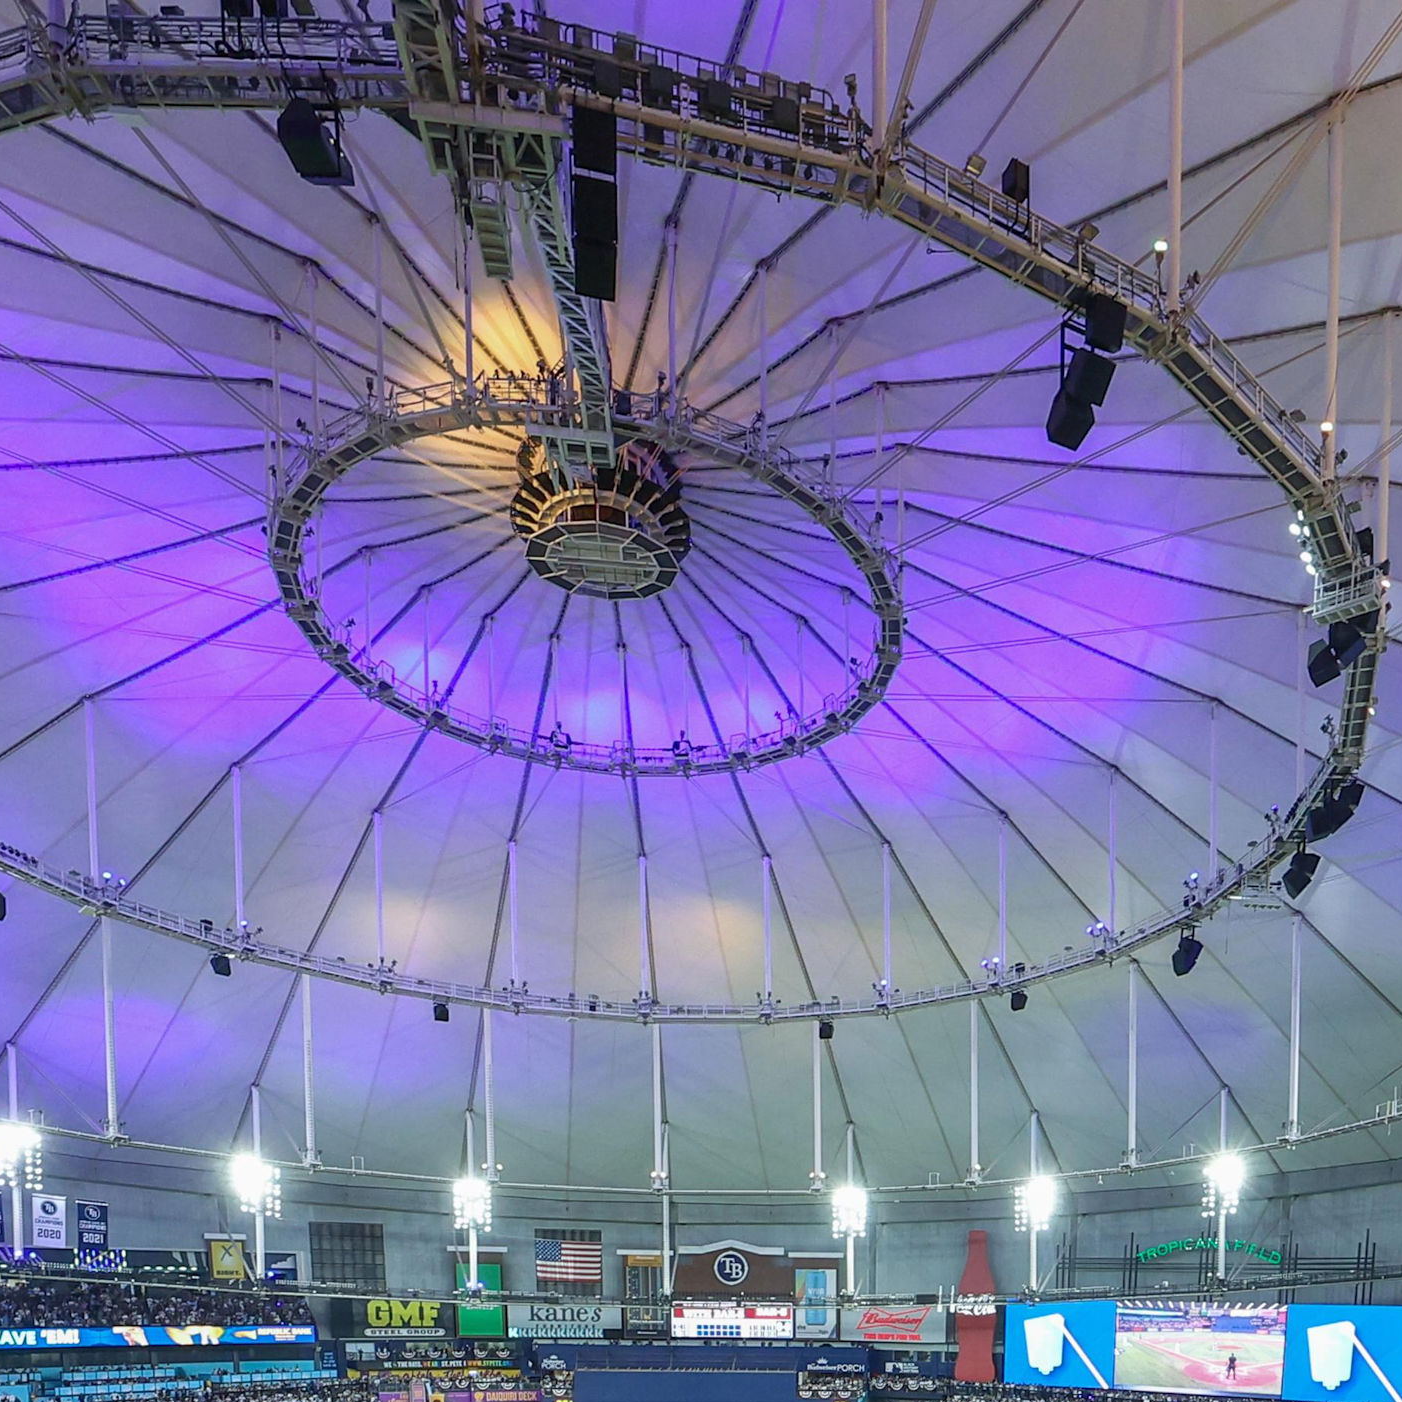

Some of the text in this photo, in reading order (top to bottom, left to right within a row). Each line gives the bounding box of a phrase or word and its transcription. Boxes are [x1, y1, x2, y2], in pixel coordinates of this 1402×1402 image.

[37, 1229, 61, 1240] 2020
[82, 1233, 104, 1244] 2021
[720, 1257, 743, 1278] TB
[367, 1300, 441, 1327] GMF
[863, 1312, 923, 1326] Budweiser
[40, 1328, 81, 1345] 'EM!
[406, 1328, 441, 1336] GROUP
[837, 1364, 865, 1372] PORCH
[486, 1391, 538, 1401] DAIQUIRI DECK
